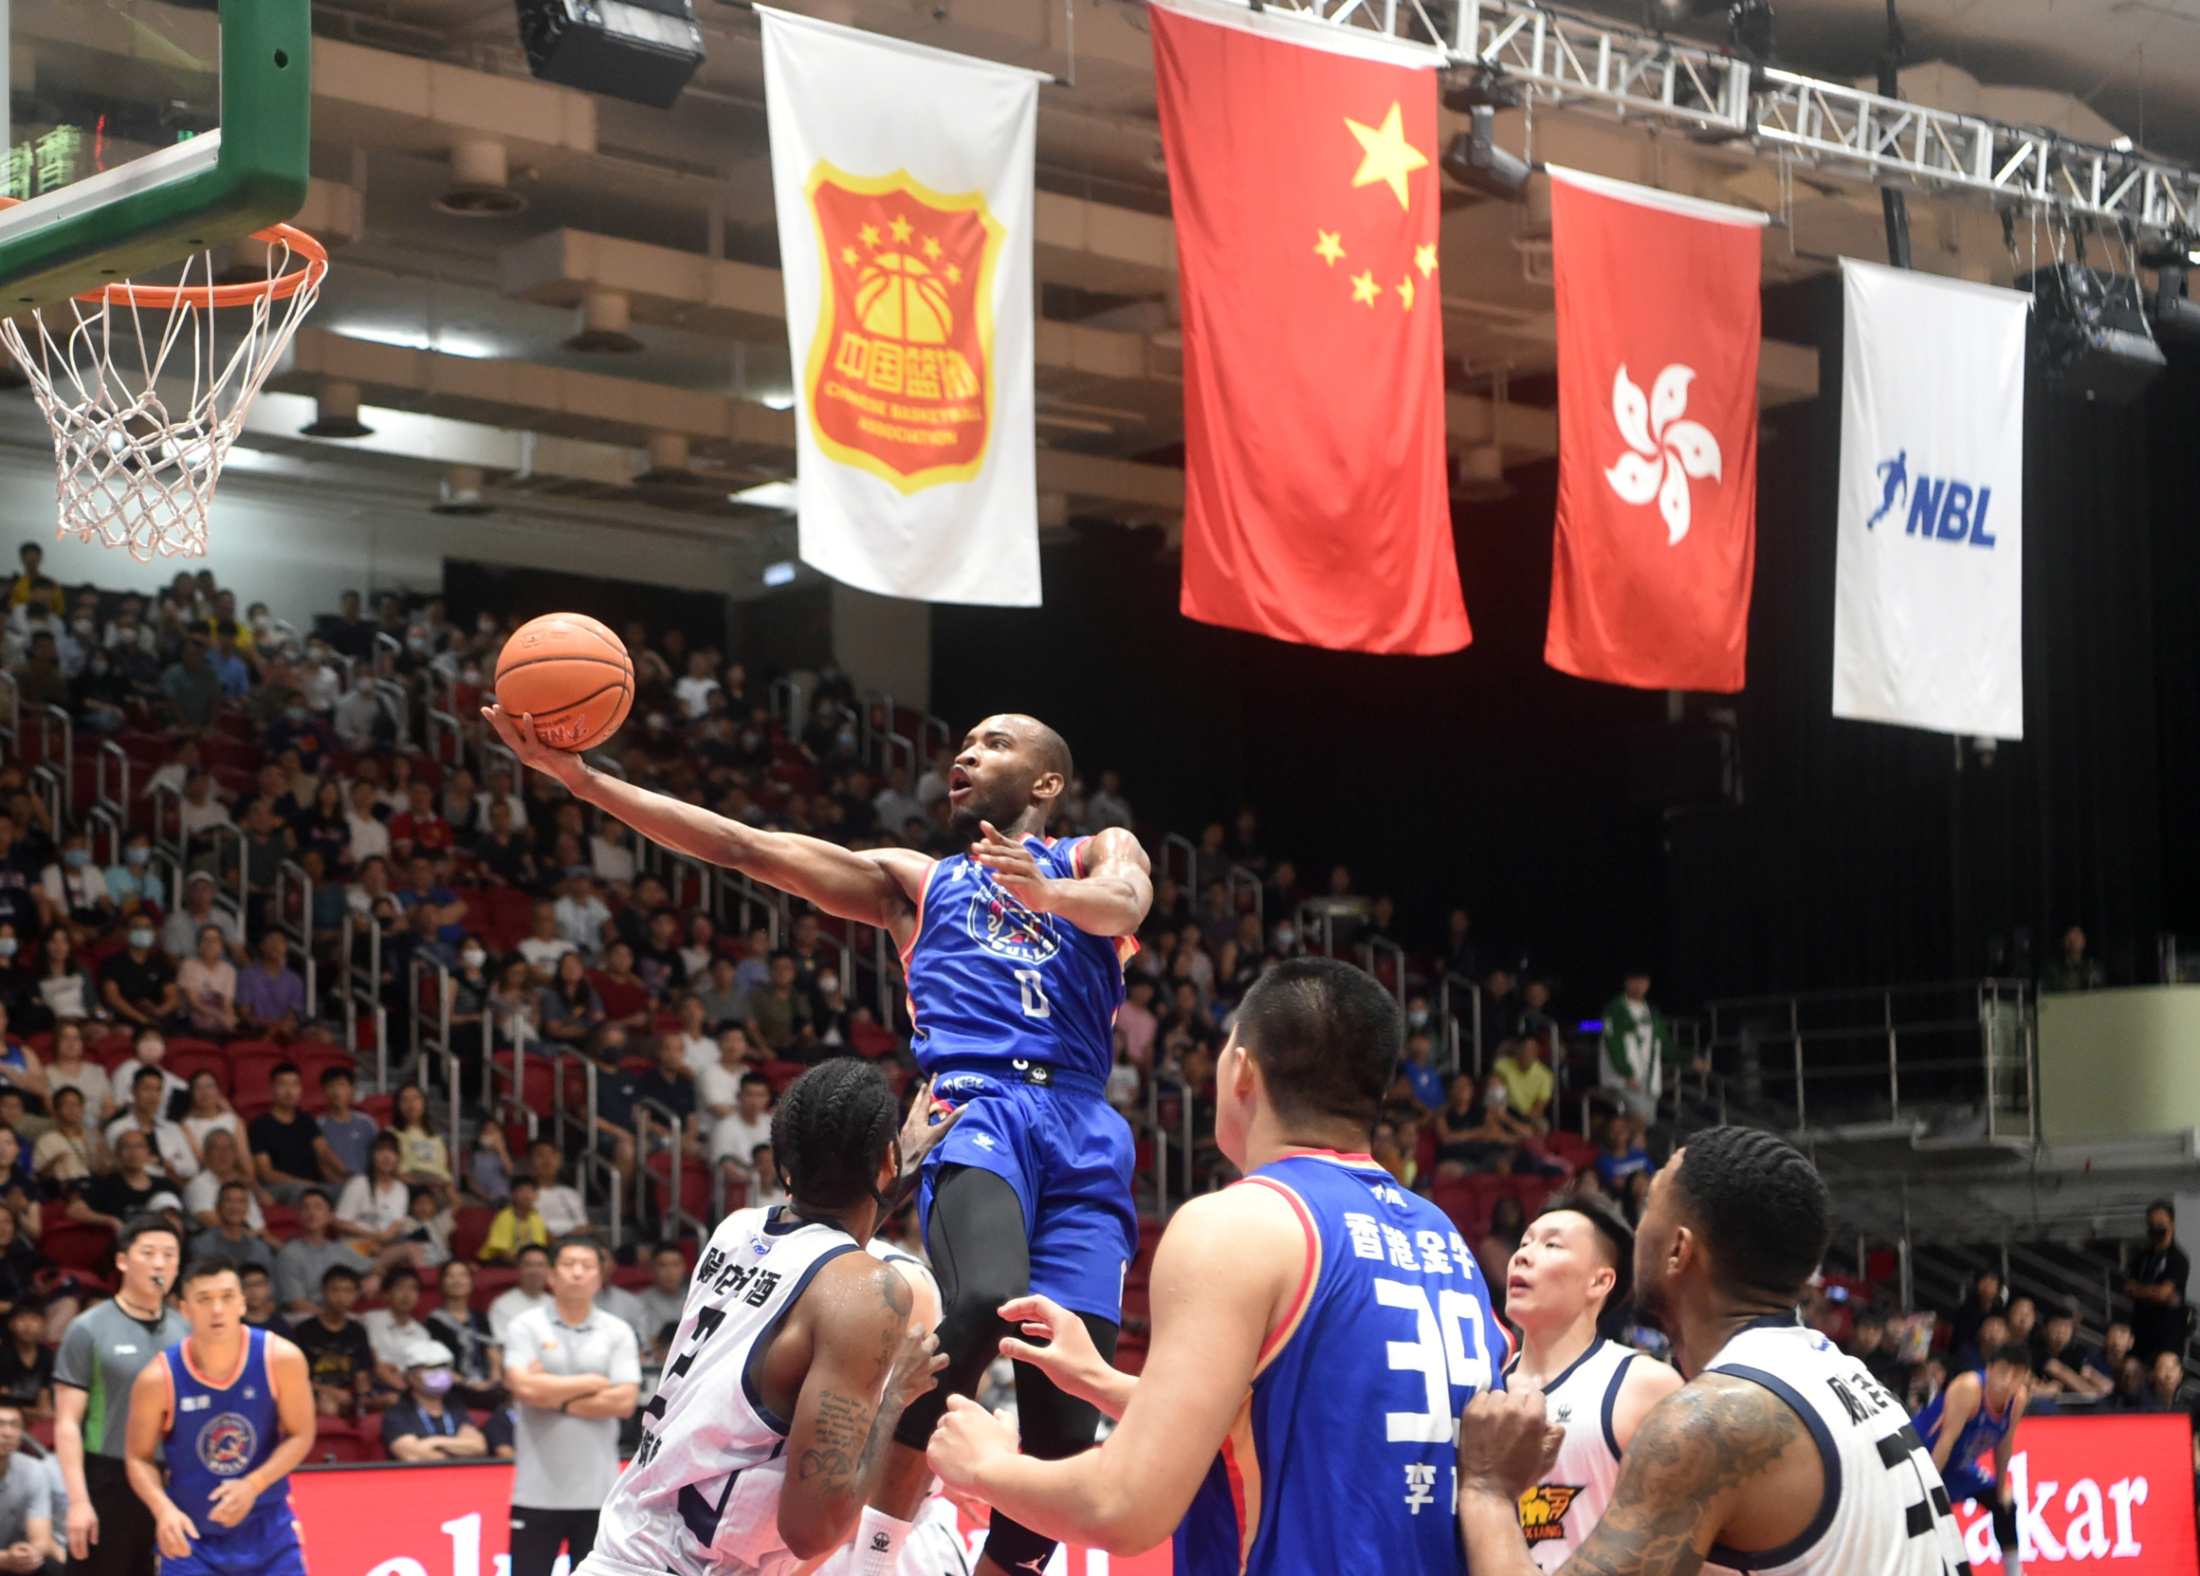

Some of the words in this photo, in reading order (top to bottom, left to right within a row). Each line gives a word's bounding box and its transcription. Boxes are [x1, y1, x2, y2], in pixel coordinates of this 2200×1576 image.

[1906, 474, 1995, 548] NBL
[1014, 969, 1051, 1018] 0
[1343, 1212, 1475, 1280] 香港金牛
